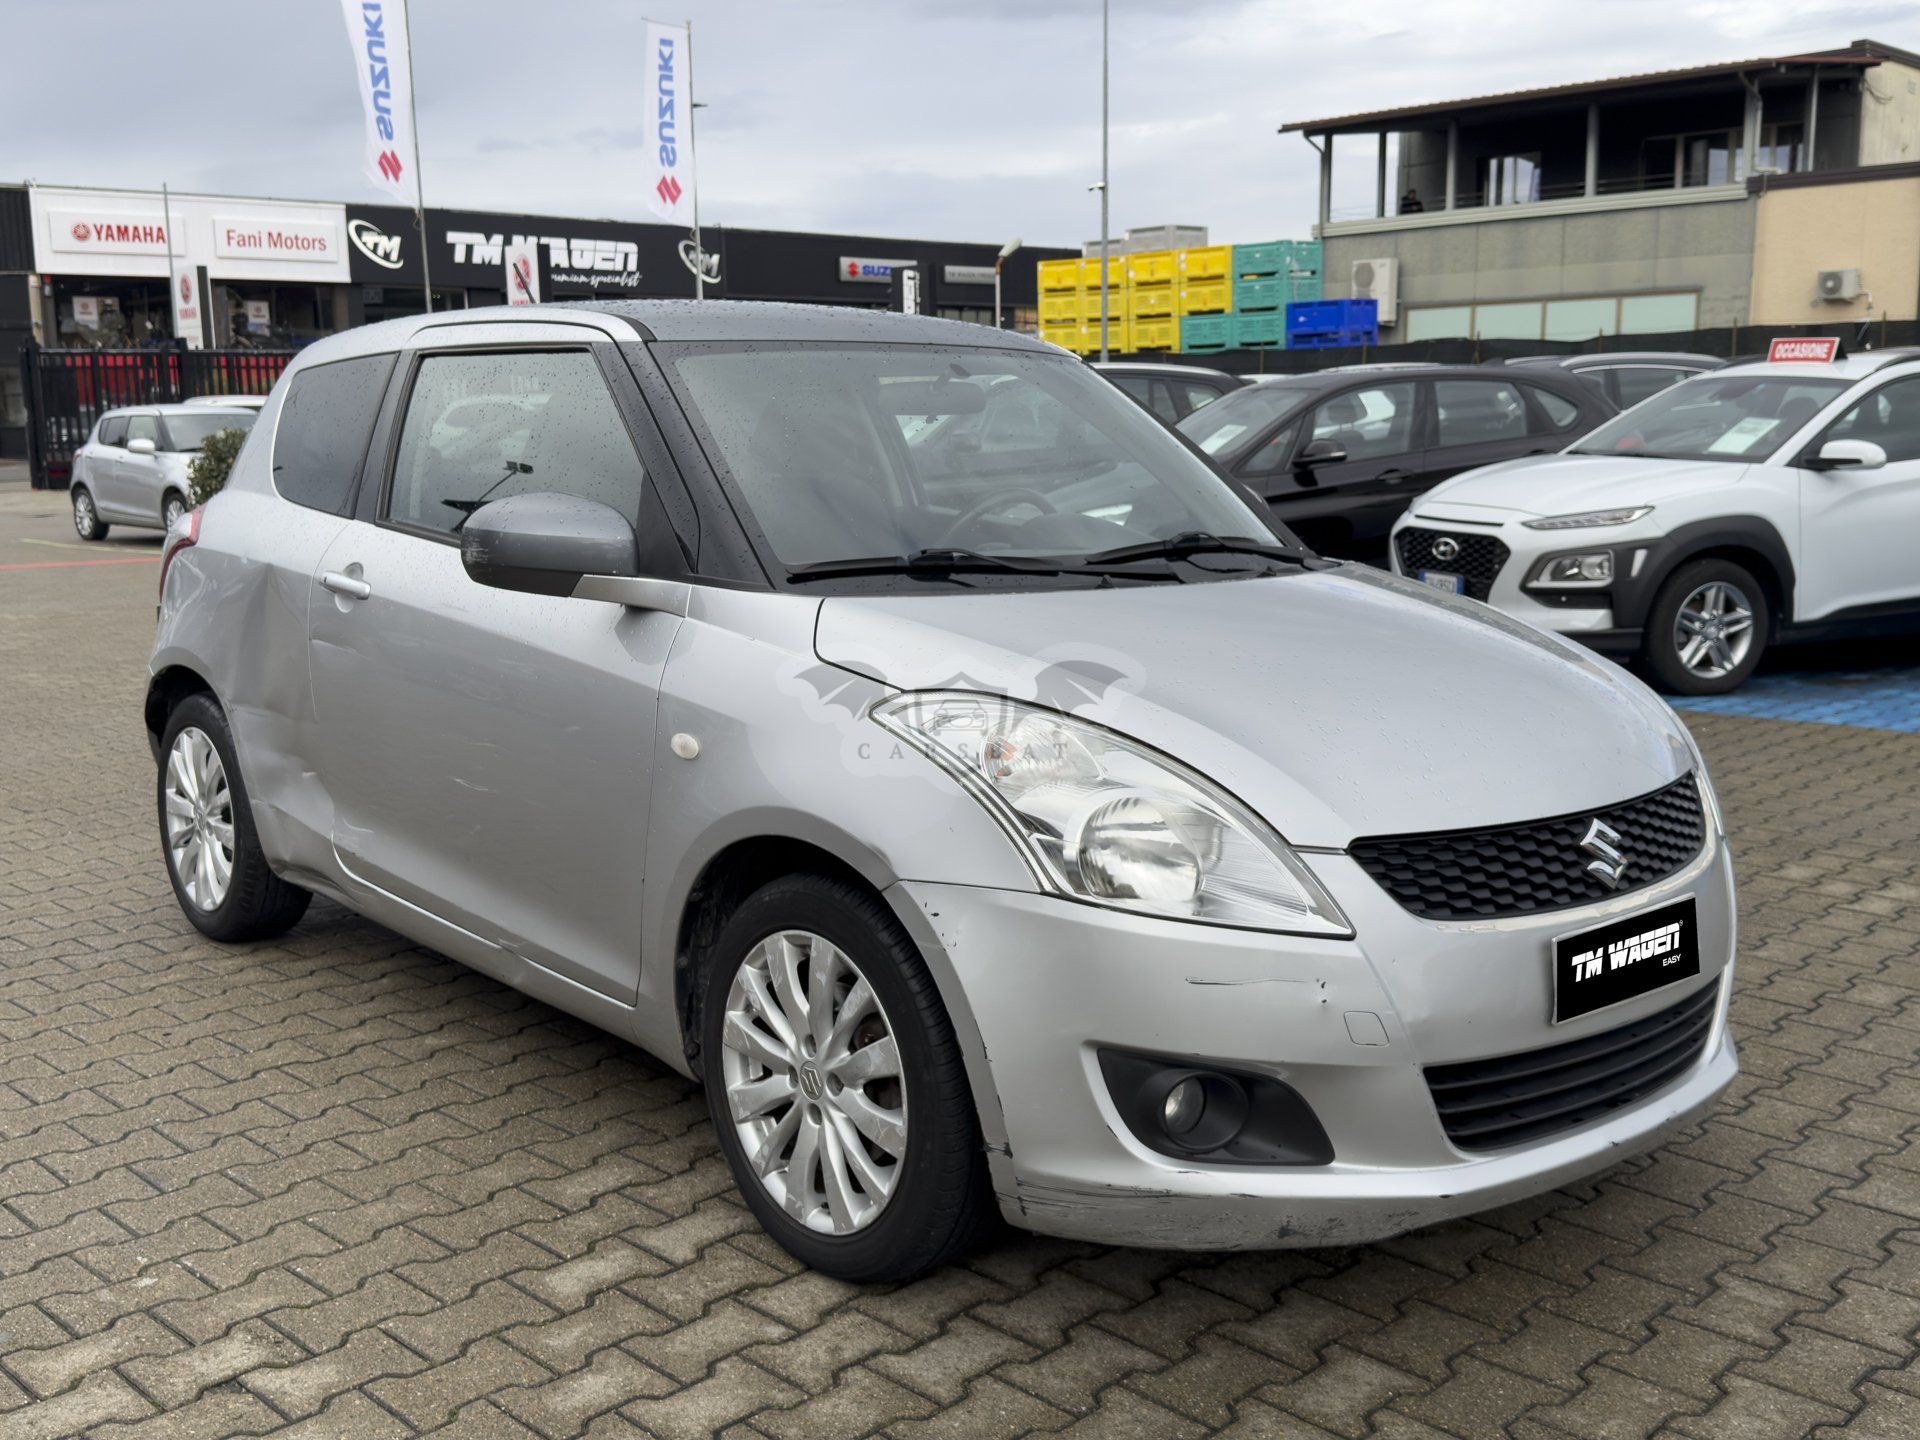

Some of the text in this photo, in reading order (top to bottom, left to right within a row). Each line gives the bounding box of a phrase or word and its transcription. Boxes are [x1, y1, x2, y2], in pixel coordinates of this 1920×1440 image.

[93, 223, 167, 244] YAMAHA
[226, 228, 327, 252] Fani Motors
[446, 231, 504, 265] TM
[1775, 342, 1830, 359] OCCASIONE
